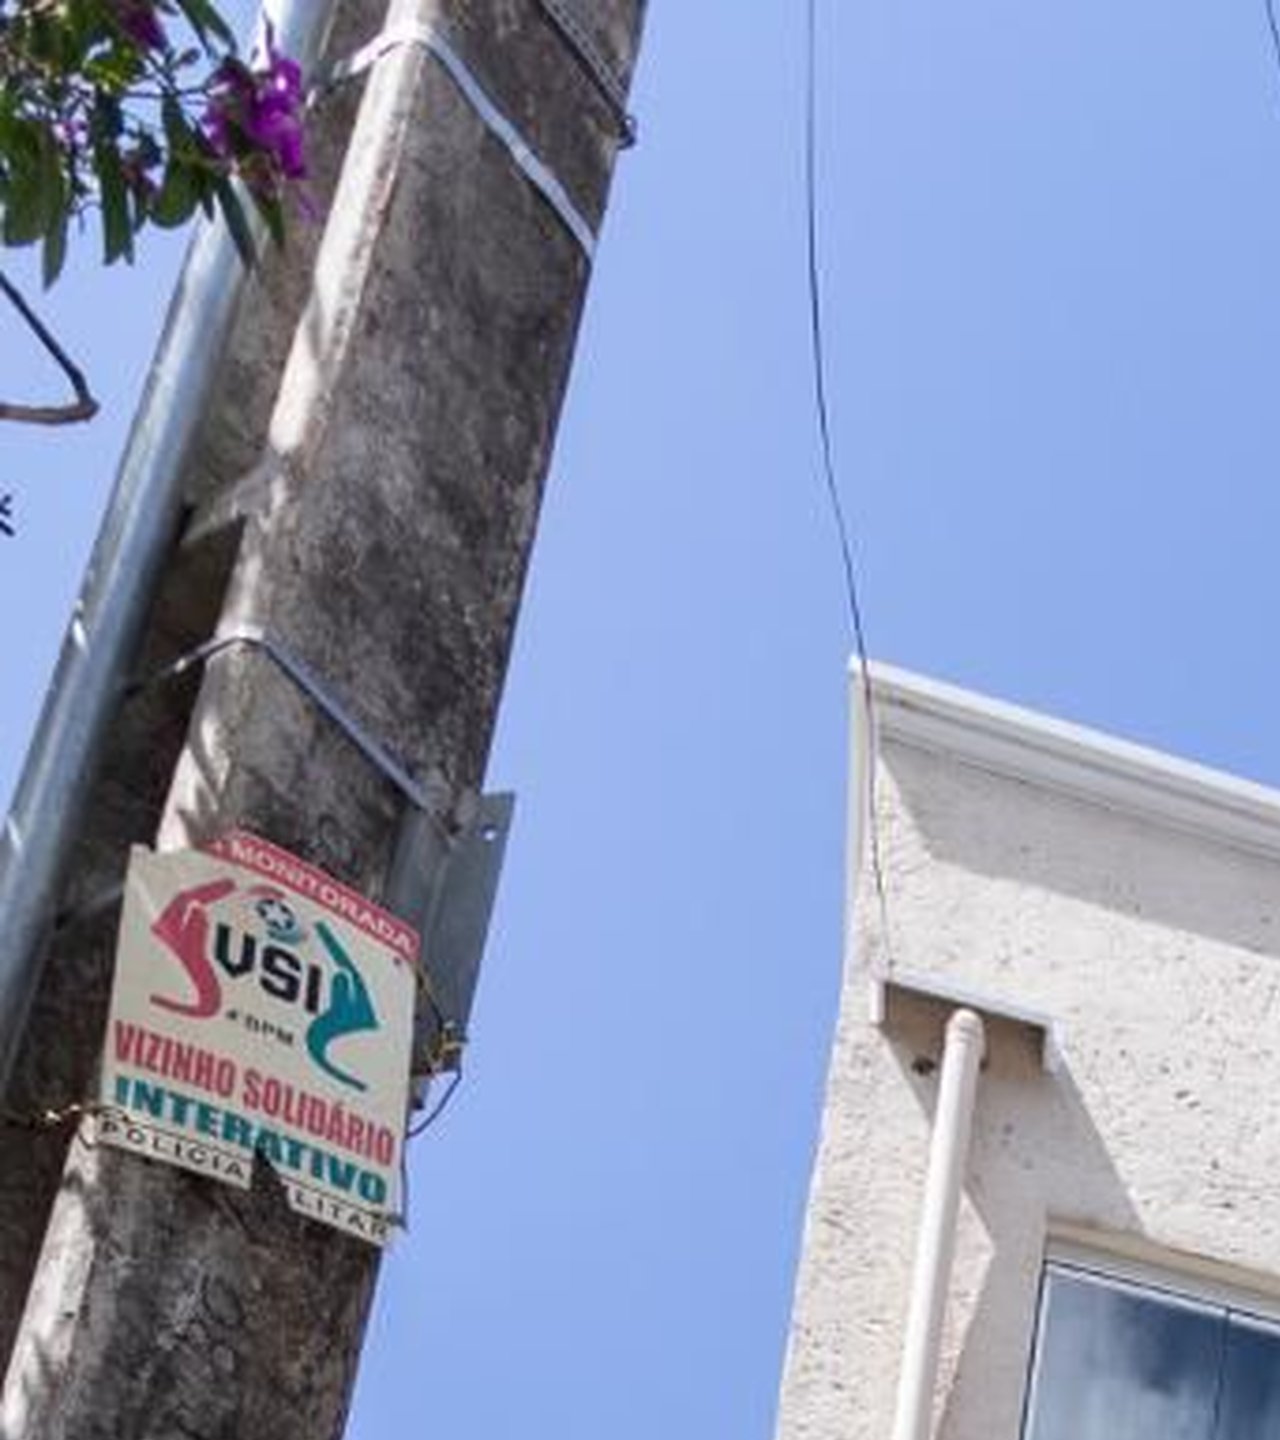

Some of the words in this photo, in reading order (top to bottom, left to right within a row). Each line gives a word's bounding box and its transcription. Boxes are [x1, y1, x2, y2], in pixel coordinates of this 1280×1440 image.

[230, 838, 412, 950] MONITORADA
[114, 1019, 236, 1097] VIZINHO
[243, 1067, 394, 1167] SOLIDÁRIO
[115, 1074, 387, 1203] INTERATIVO
[294, 1188, 387, 1237] LITAR
